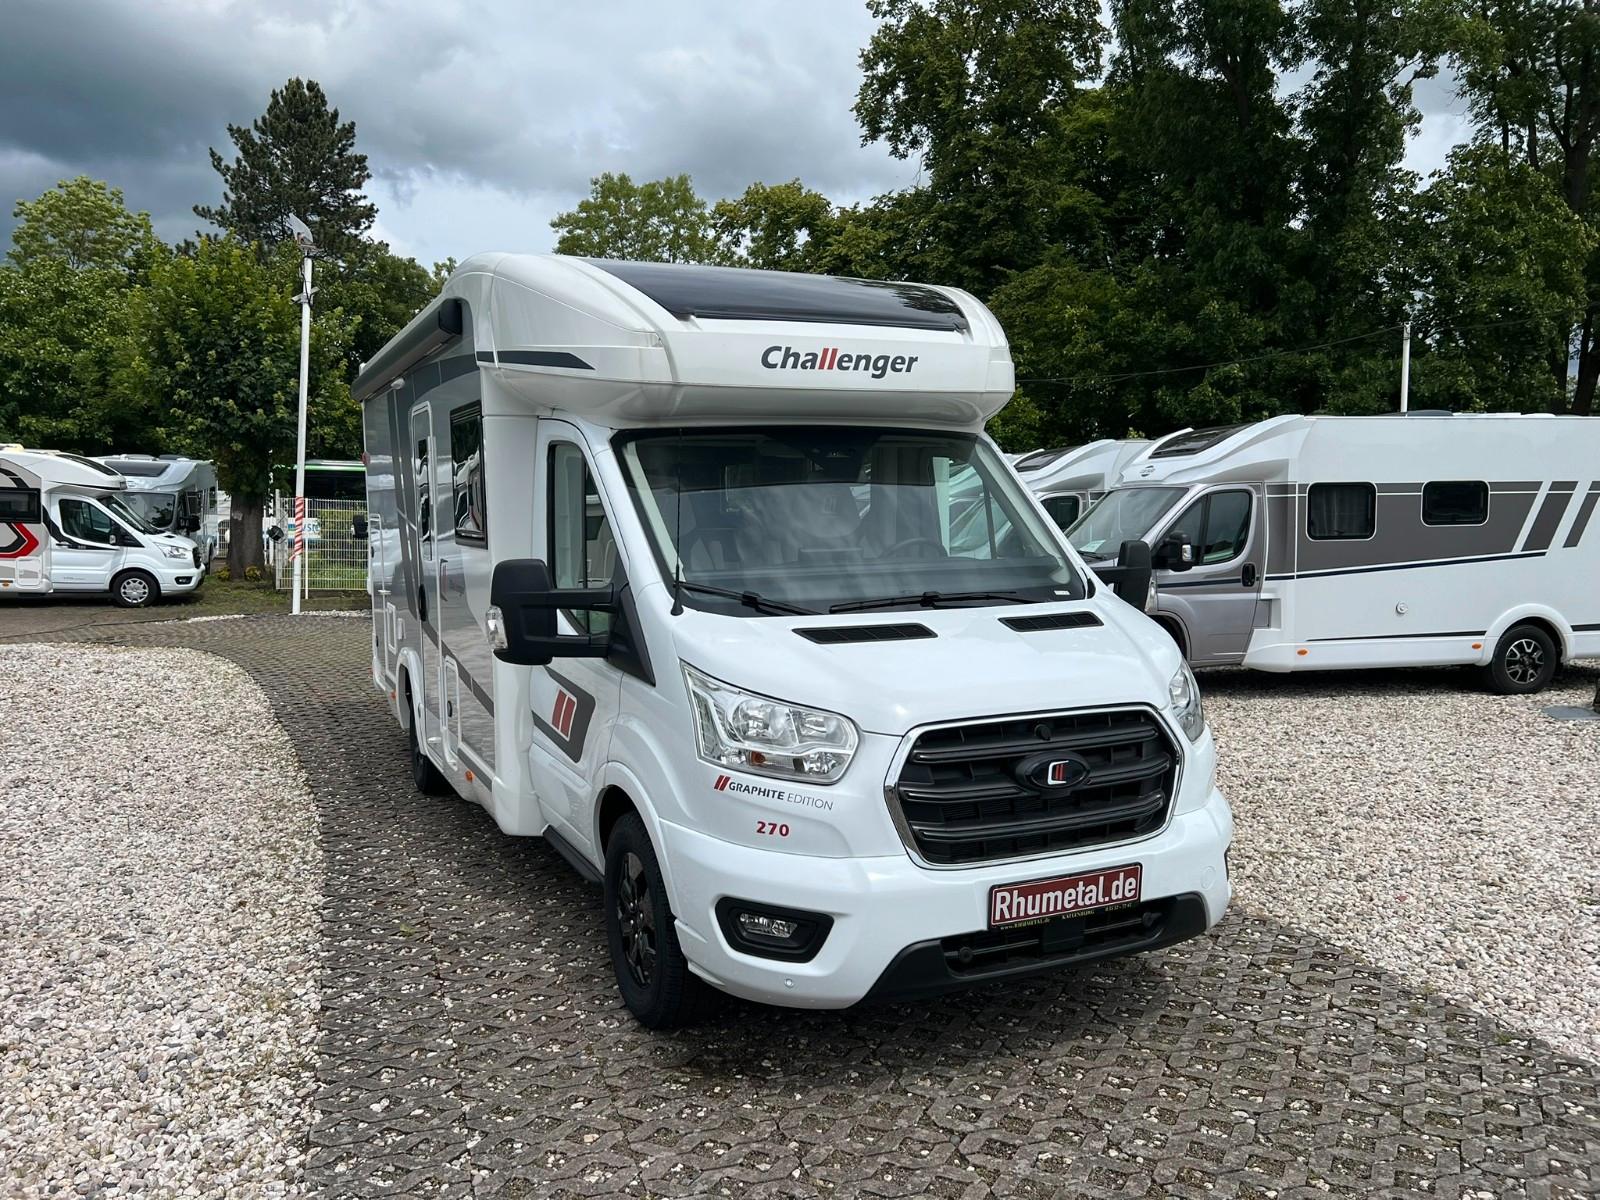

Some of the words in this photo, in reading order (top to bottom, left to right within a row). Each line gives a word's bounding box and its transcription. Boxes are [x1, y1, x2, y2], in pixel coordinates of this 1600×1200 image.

[761, 345, 918, 379] Challenger
[728, 781, 785, 800] GRAPHITE
[787, 792, 834, 811] EDITION
[756, 820, 790, 837] 270
[994, 872, 1137, 921] Rhumetal.de
